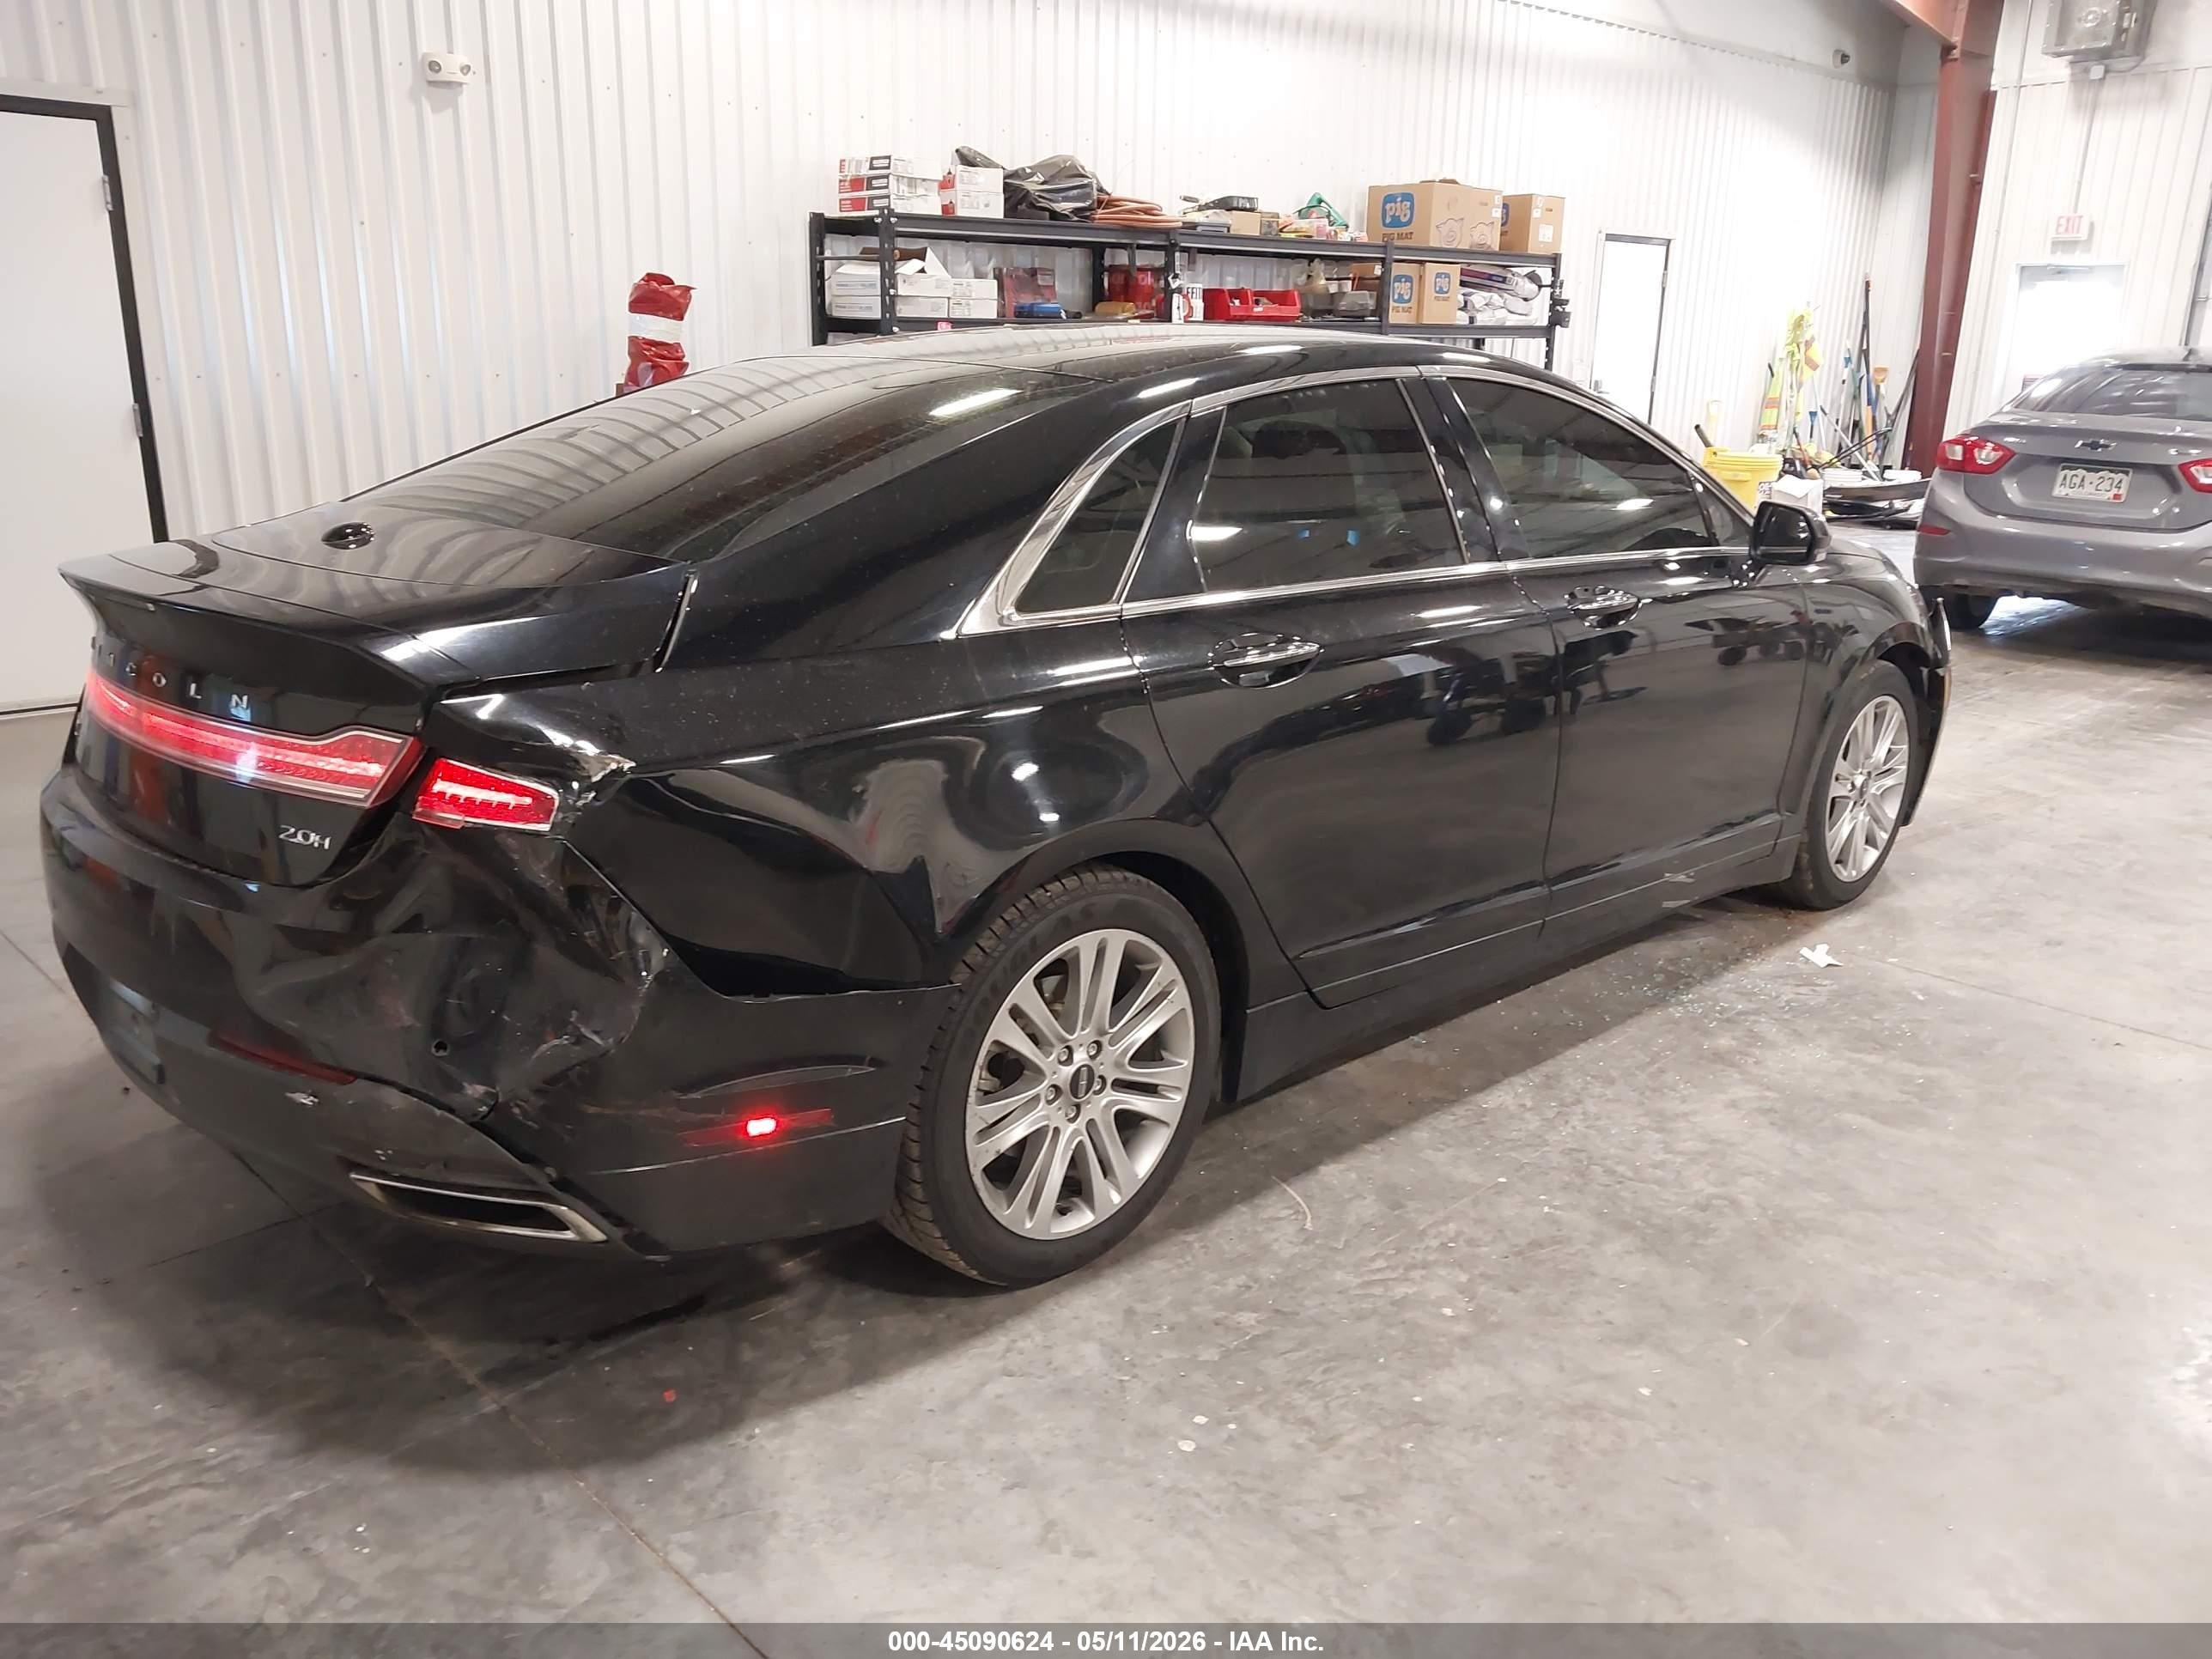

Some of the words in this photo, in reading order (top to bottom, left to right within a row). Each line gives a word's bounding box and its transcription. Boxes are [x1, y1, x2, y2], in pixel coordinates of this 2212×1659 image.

[1385, 197, 1411, 223] pig
[2055, 215, 2083, 235] EXIT
[1396, 232, 1414, 240] MAT
[1394, 278, 1411, 300] pig
